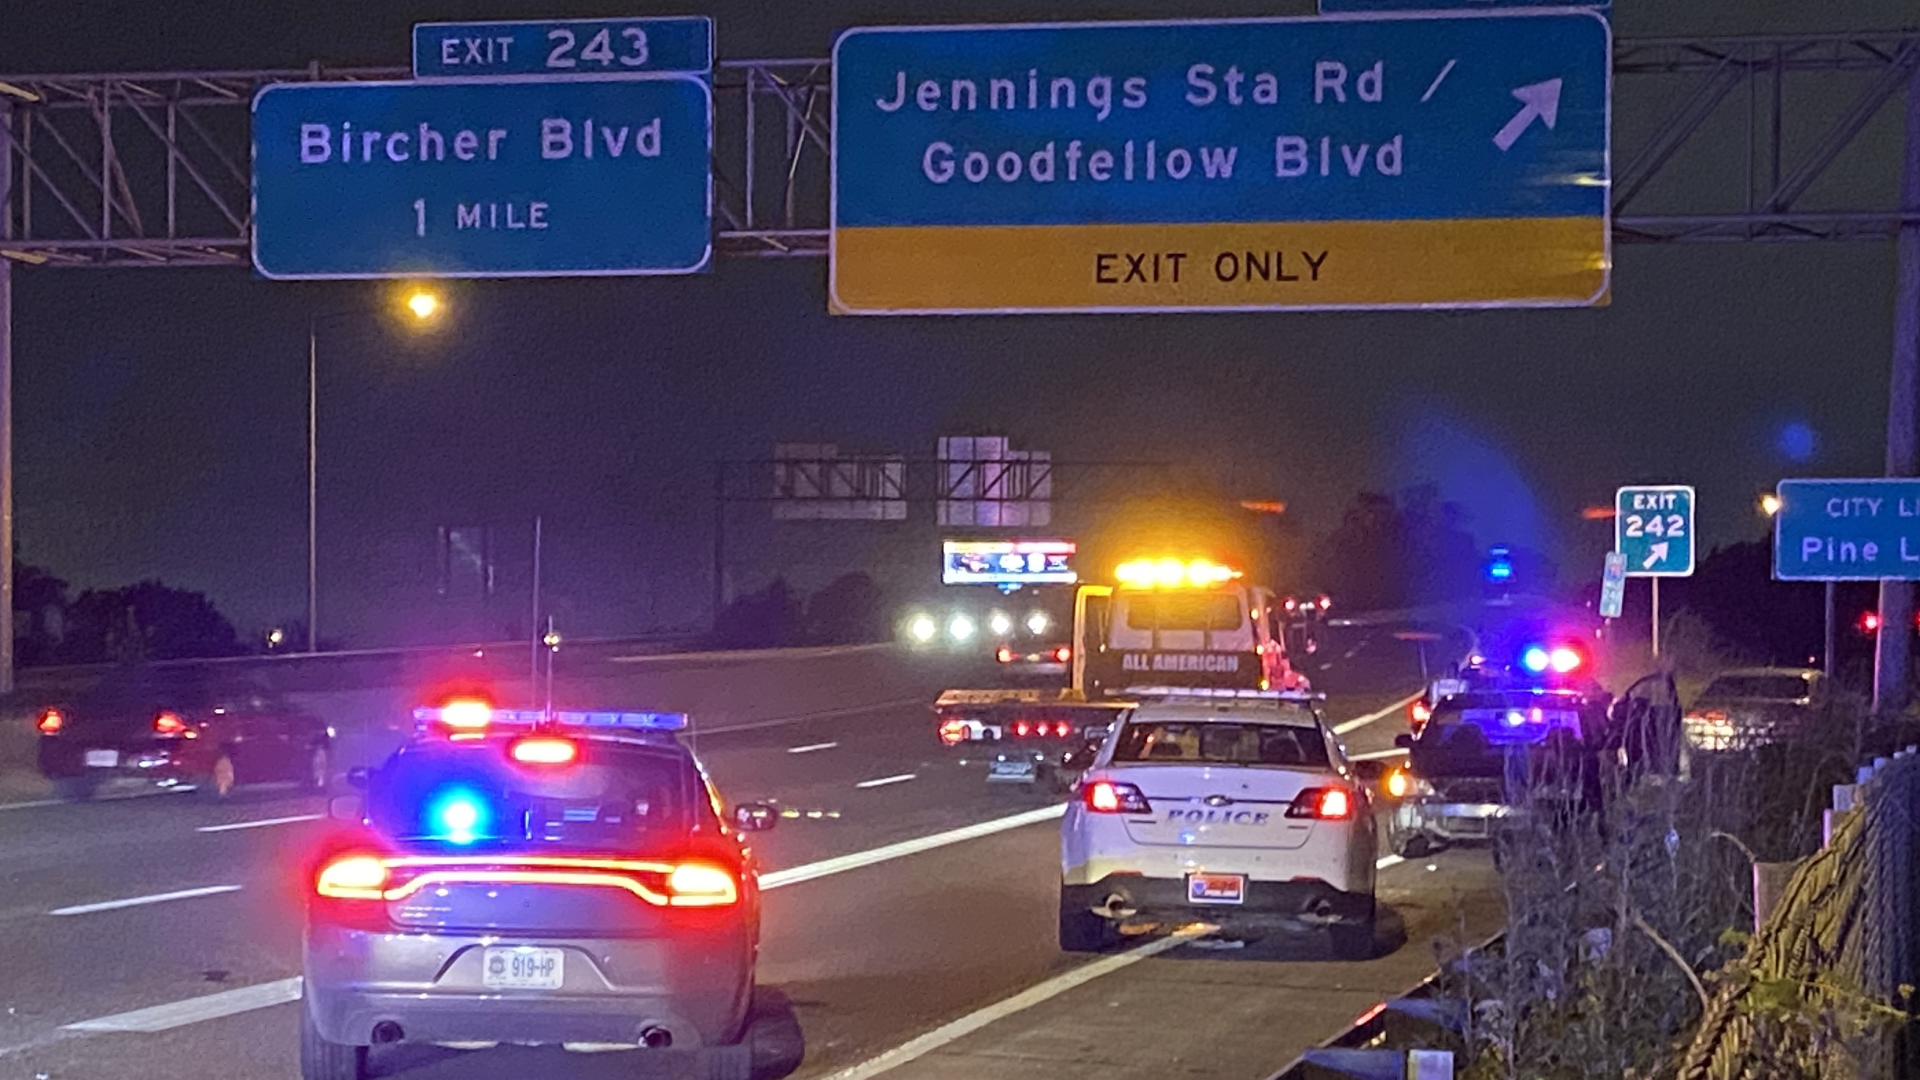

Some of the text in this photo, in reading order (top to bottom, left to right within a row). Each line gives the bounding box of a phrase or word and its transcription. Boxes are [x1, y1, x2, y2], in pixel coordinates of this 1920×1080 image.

[441, 27, 650, 68] EXIT 243
[876, 59, 1457, 121] Jennings Sta Rd /
[300, 118, 662, 164] Bircher Blvd
[922, 135, 1403, 184] Goodfellow Blvd
[414, 198, 549, 236] 1 MILE
[1095, 250, 1329, 284] EXIT ONLY
[1633, 494, 1677, 510] EXIT
[1826, 497, 1883, 518] CITY
[1626, 514, 1685, 537] 242
[1802, 536, 1879, 562] Pine
[1122, 653, 1239, 672] ALL AMERICAN
[1166, 809, 1269, 825] POLICE
[512, 955, 555, 978] 919-HP
